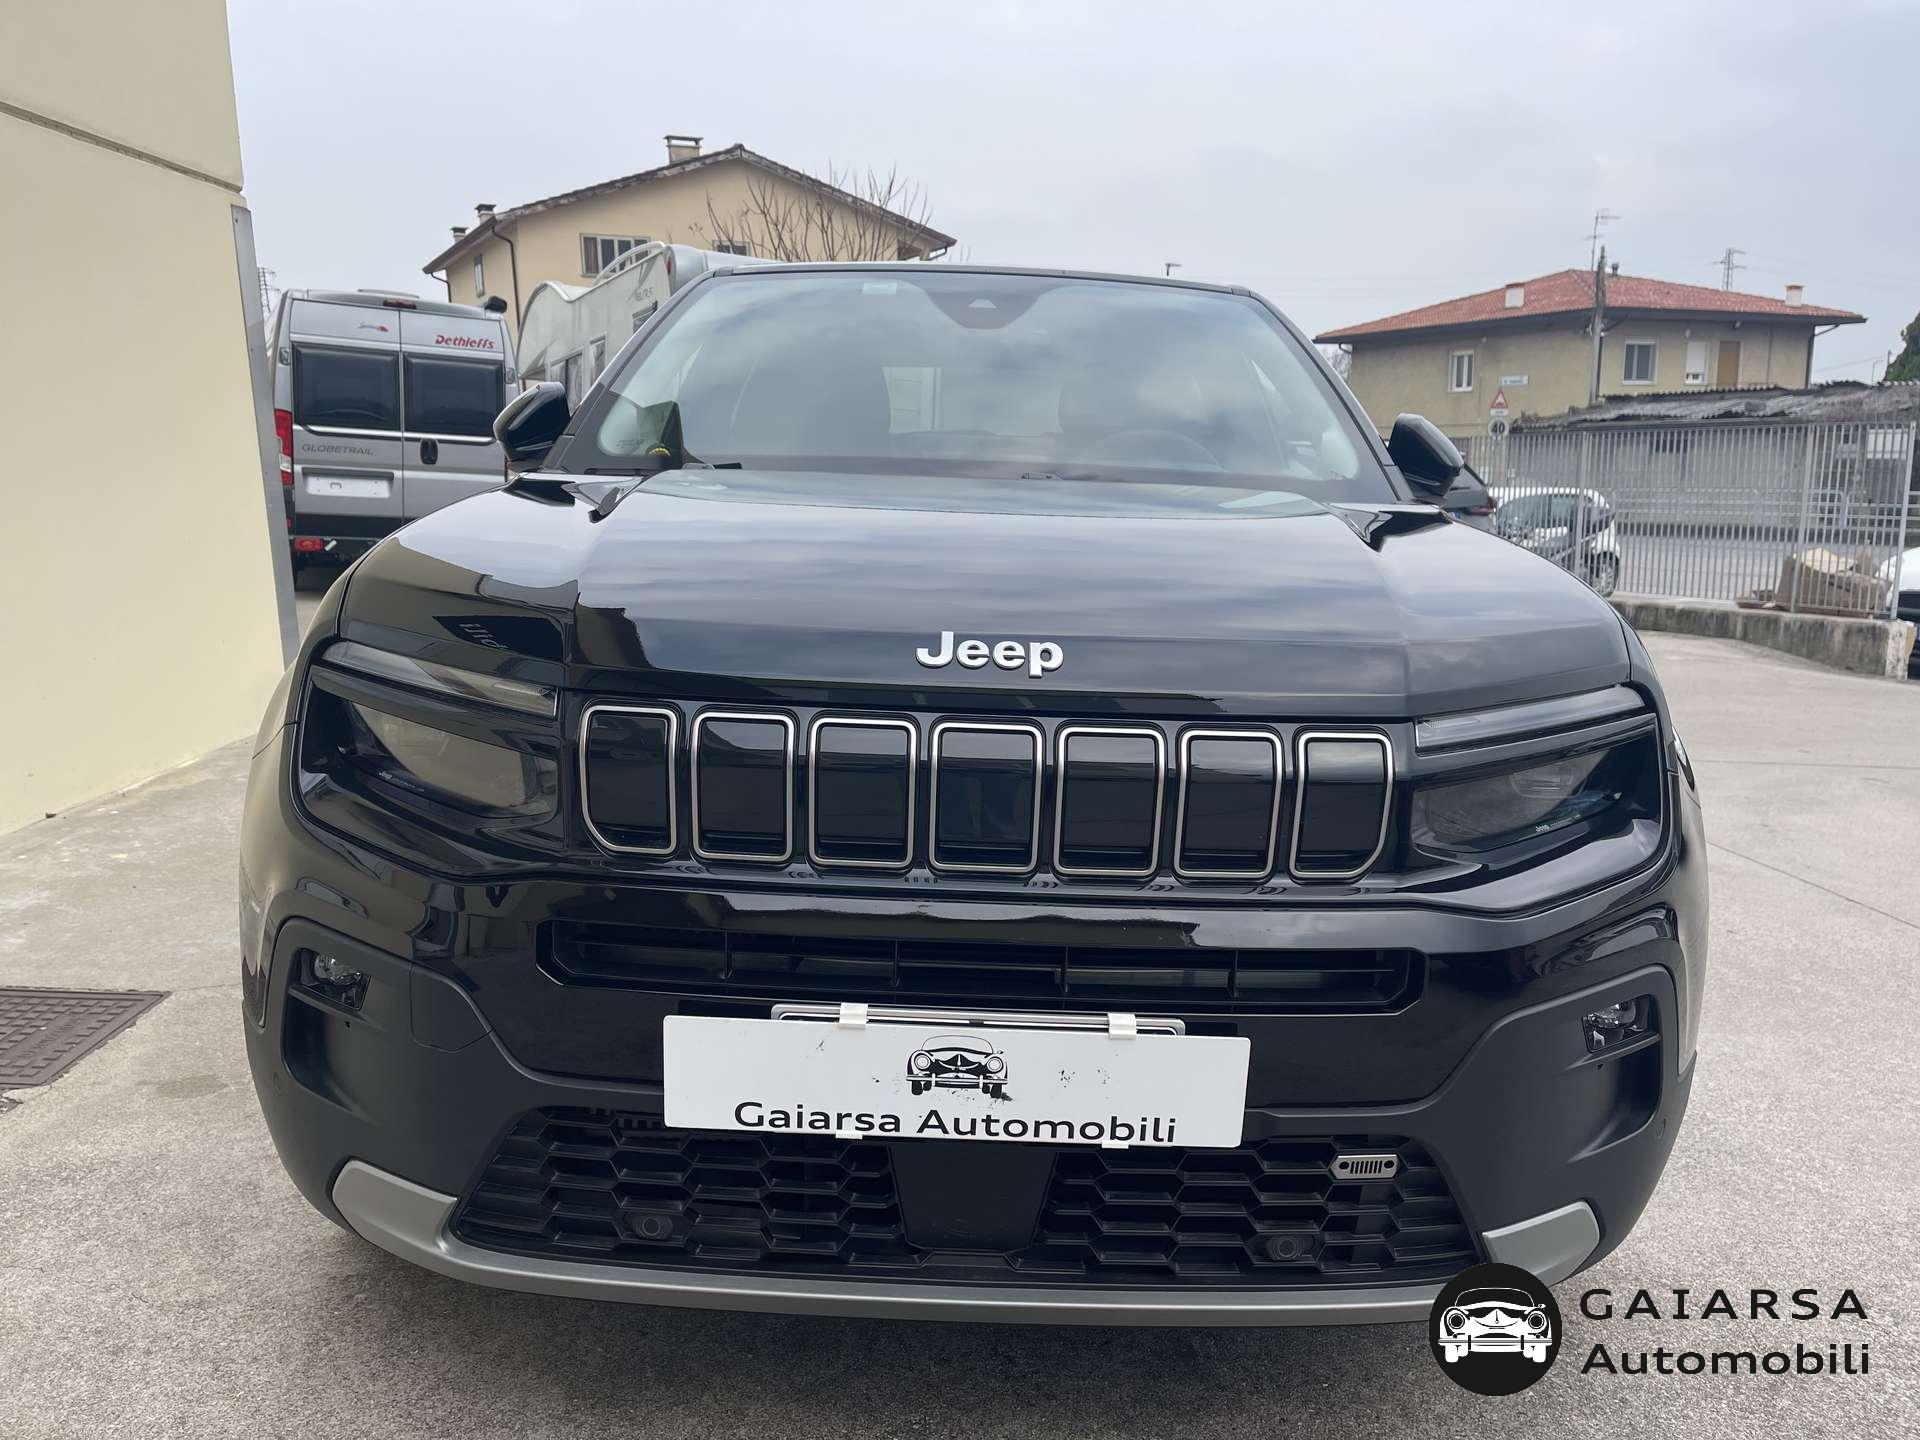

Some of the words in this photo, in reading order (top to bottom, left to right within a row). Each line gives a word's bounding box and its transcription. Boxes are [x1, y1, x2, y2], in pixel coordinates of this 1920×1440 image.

[434, 334, 495, 350] Dethleffs
[1491, 422, 1506, 433] 40
[302, 443, 374, 456] GLOBETRAIL
[916, 631, 1064, 678] Jeep
[734, 1101, 901, 1133] Gaiarsa
[916, 1109, 1175, 1143] Automobili
